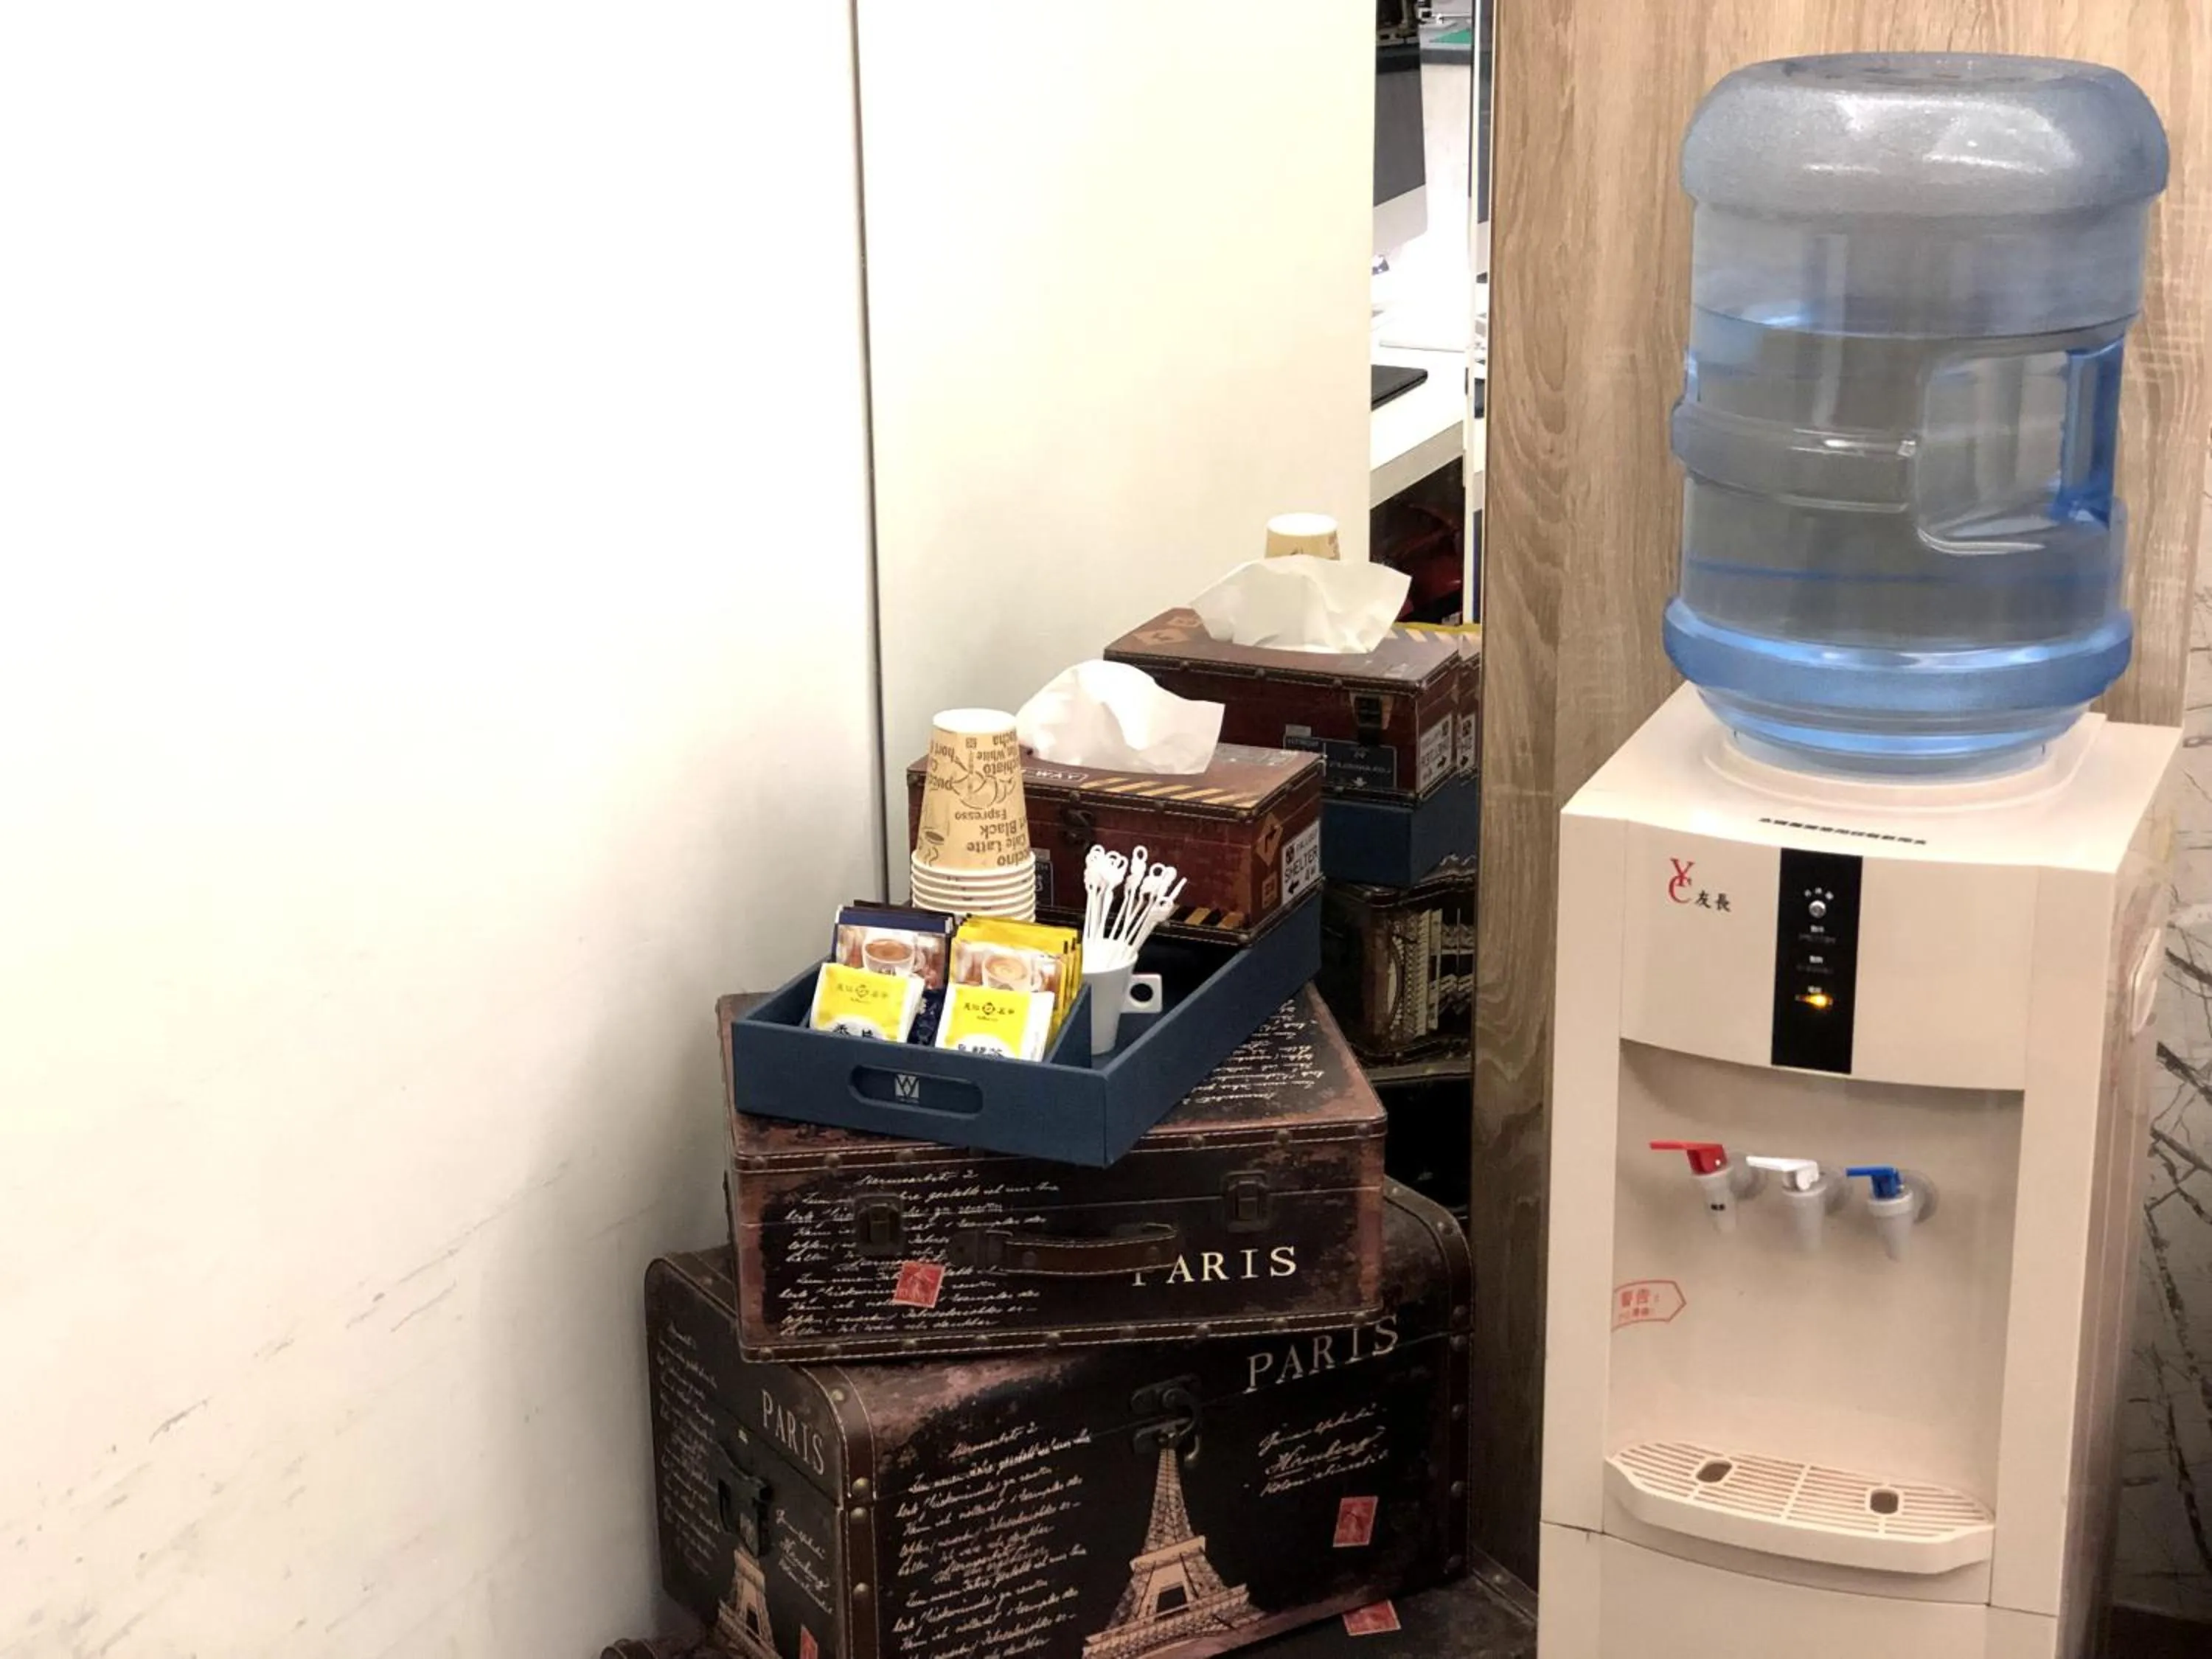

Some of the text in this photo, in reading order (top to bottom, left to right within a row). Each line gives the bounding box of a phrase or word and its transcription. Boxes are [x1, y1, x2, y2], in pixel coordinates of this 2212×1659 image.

[955, 808, 1007, 821] Espresso
[980, 821, 1018, 840] Black
[966, 840, 1002, 854] Latte
[1242, 1313, 1399, 1394] PARIS
[760, 1388, 826, 1476] PARIS
